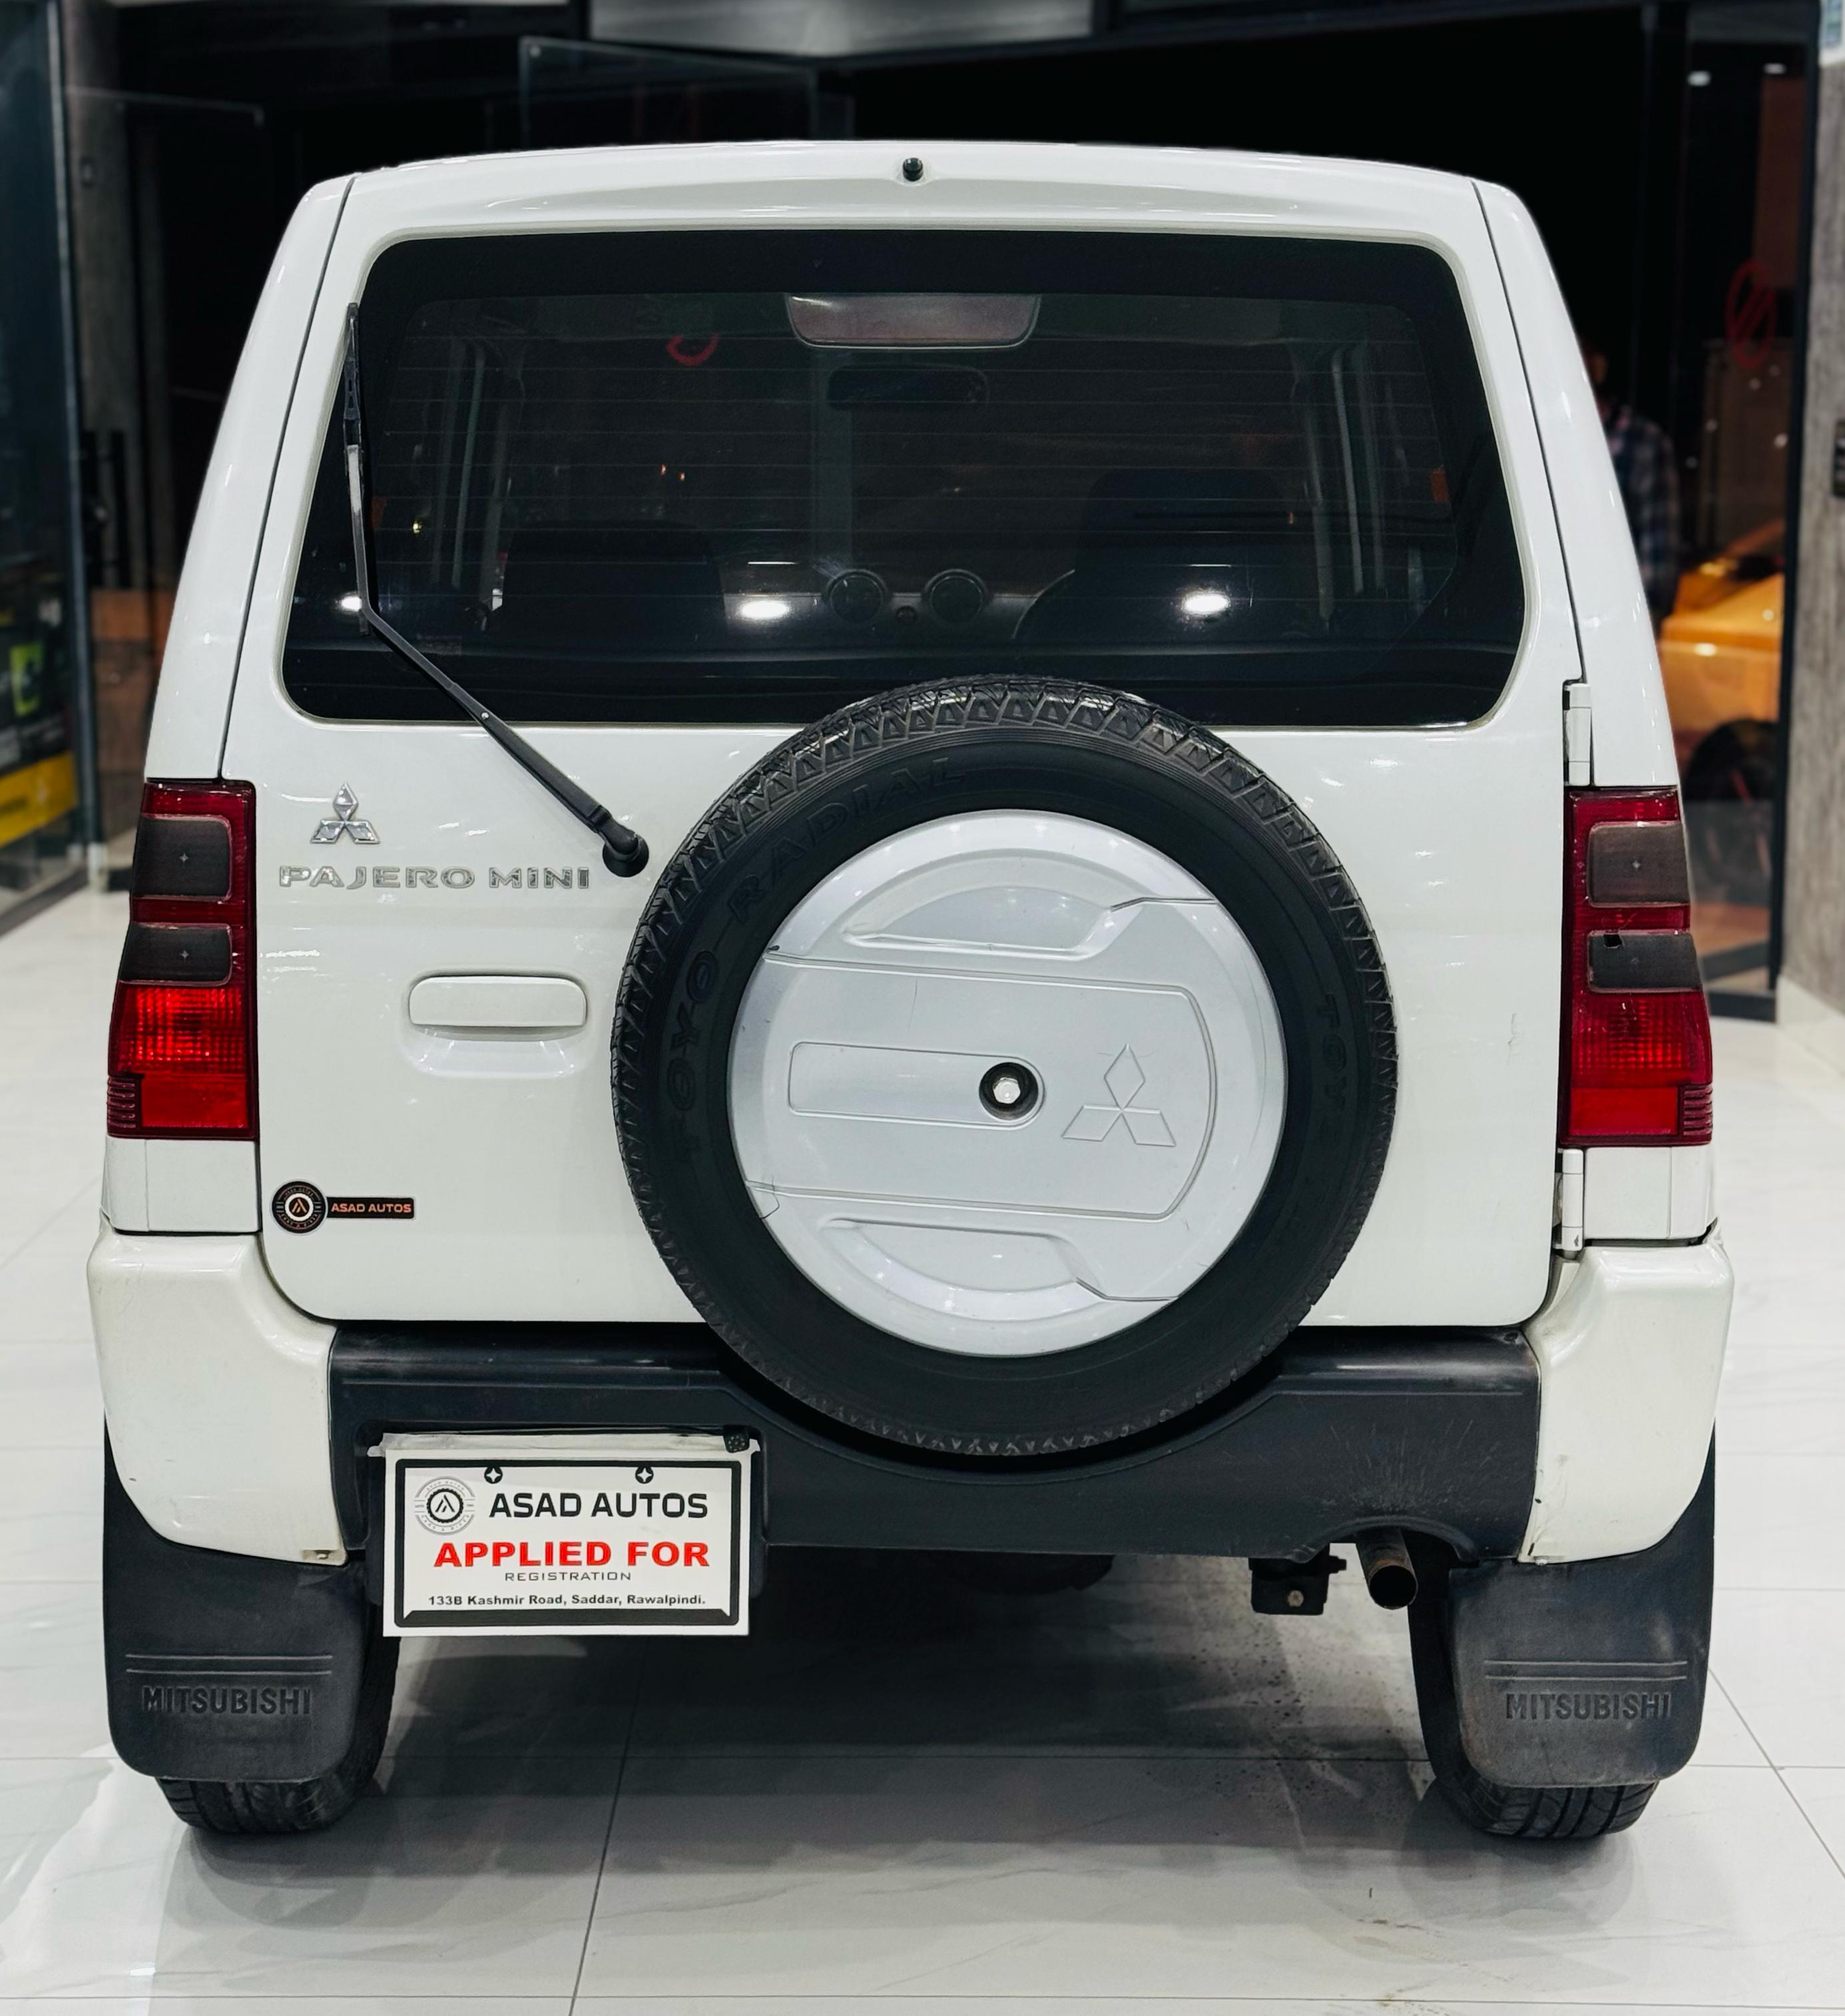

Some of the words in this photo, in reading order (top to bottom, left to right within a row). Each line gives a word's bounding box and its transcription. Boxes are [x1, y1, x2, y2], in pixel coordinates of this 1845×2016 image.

[726, 756, 966, 923] RADIAL
[279, 866, 475, 889] PAJERO
[488, 866, 591, 889] MINI
[331, 1203, 366, 1213] ASAD
[368, 1203, 411, 1214] AUTOS
[489, 1493, 582, 1518] ASAD
[591, 1493, 708, 1518] AUTOS
[433, 1542, 611, 1567] APPLIED
[627, 1541, 710, 1567] FOR
[505, 1572, 631, 1581] REGISTRATION
[429, 1595, 463, 1606] 133B
[467, 1595, 525, 1606] Kashmir
[529, 1595, 567, 1607] Road,
[571, 1595, 623, 1607] Saddar,
[627, 1595, 706, 1608] Rawalpindi.
[141, 1685, 312, 1715] MITSUBISHI
[1505, 1692, 1672, 1721] MITSUBISHI
